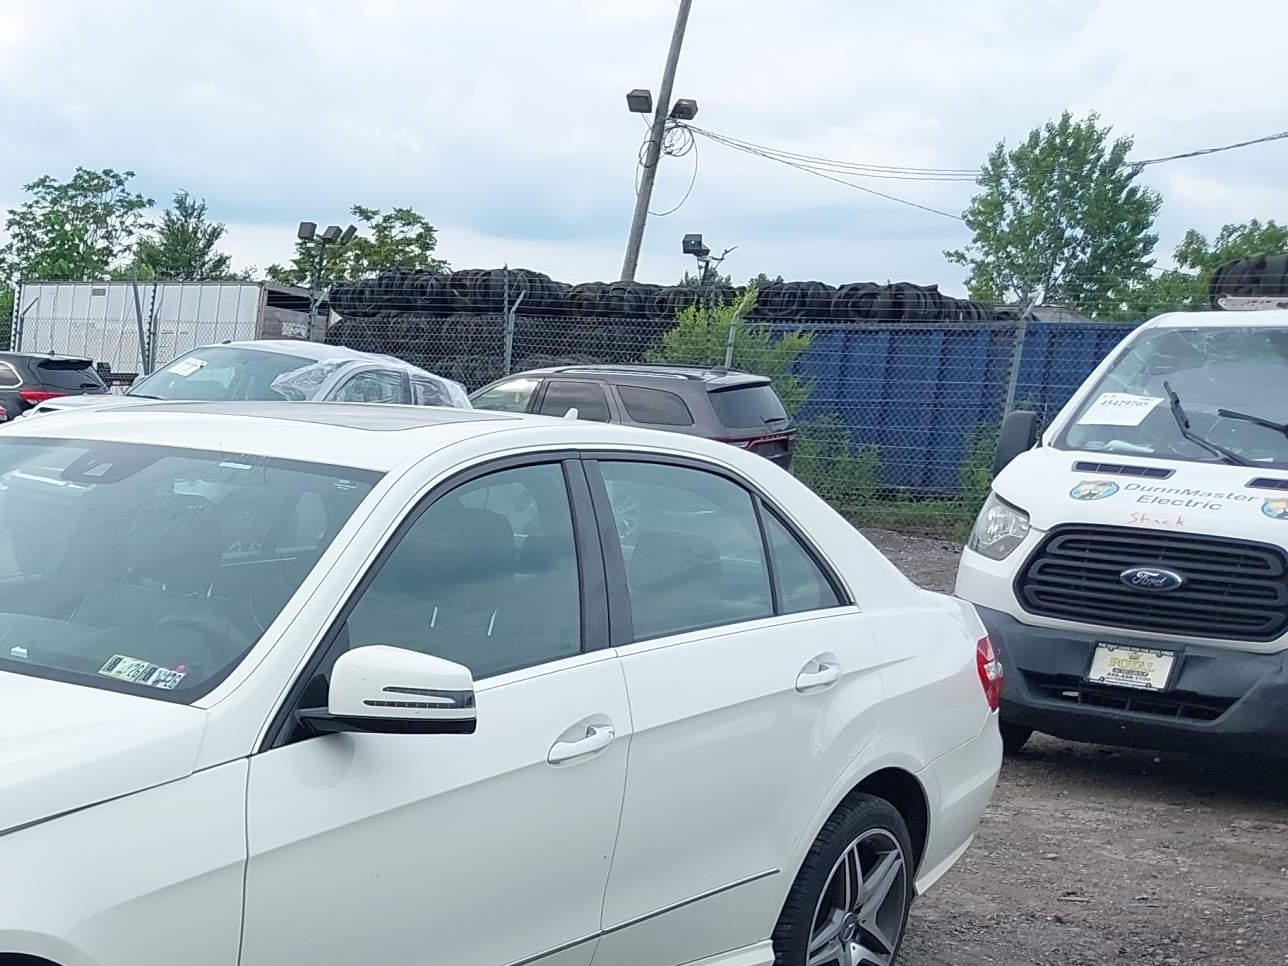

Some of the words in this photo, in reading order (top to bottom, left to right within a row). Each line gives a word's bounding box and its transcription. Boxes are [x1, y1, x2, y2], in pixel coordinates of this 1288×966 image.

[1124, 483, 1259, 503] DunnMaster
[1136, 494, 1223, 511] Electric
[1131, 571, 1168, 587] Ford
